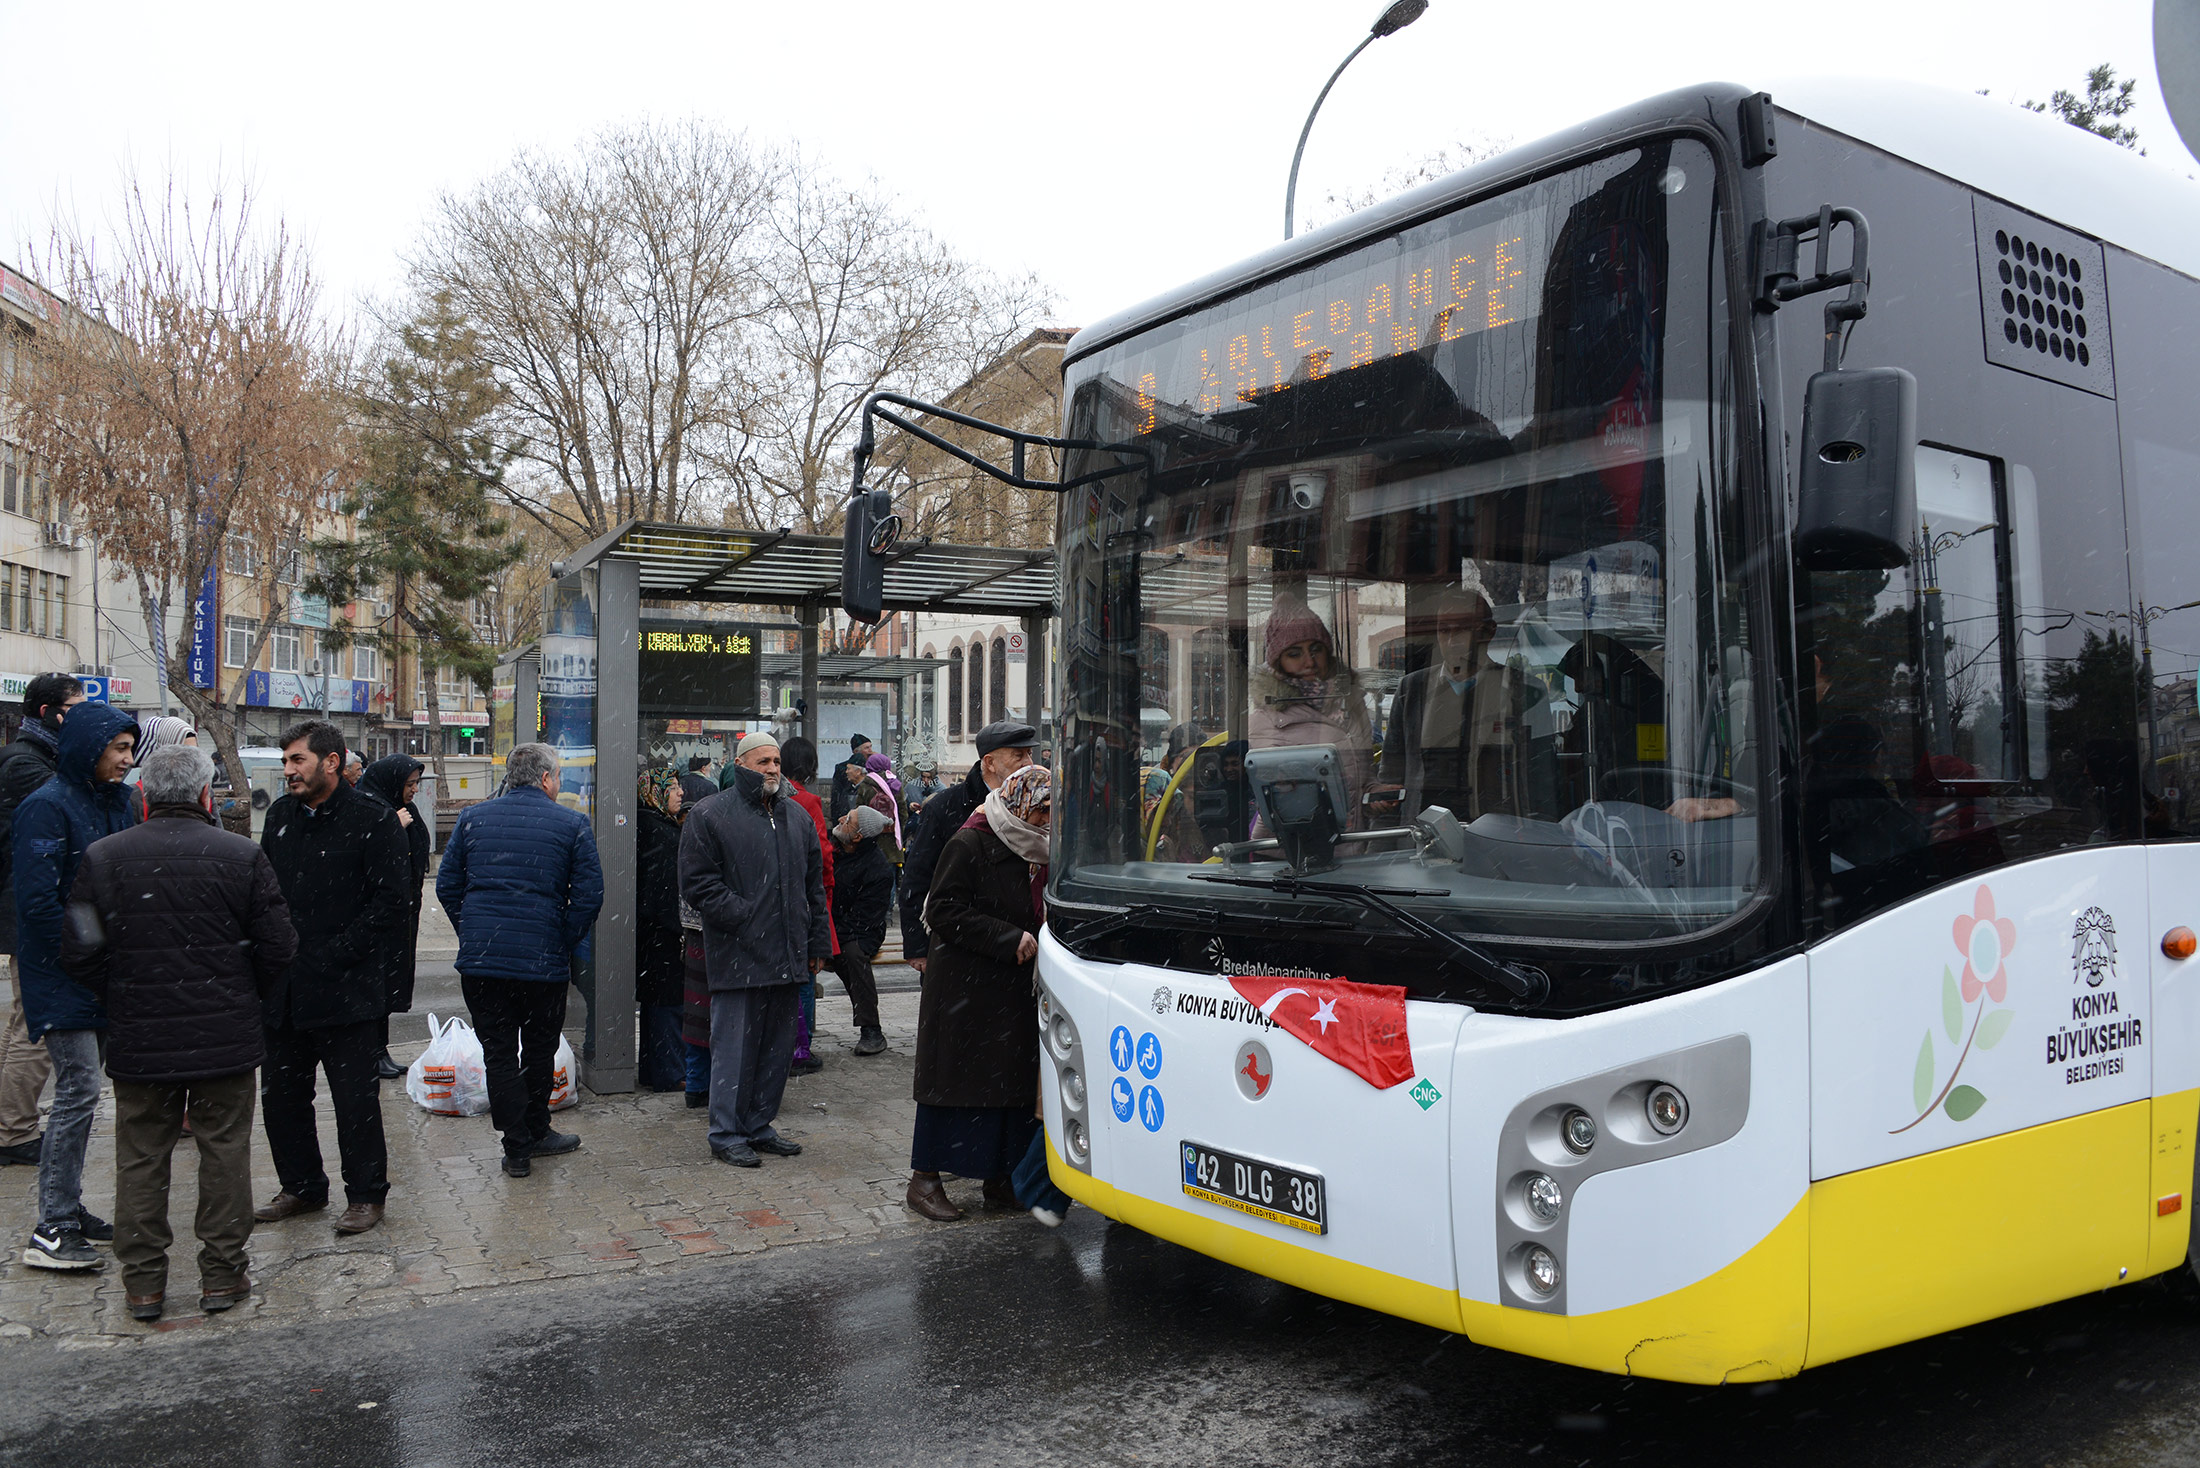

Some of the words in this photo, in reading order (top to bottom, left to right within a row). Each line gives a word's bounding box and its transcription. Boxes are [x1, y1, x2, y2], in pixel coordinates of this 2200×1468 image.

[194, 601, 205, 683] KÜLTÜR
[648, 632, 682, 642] MERAM
[713, 643, 720, 653] H
[726, 644, 751, 654] 33dk
[4, 679, 26, 695] TEXAS
[84, 680, 102, 700] P
[1177, 993, 1217, 1018] KONYA
[2072, 991, 2119, 1020] KONYA
[2046, 1013, 2142, 1064] BÜYÜKŞEHİR
[2066, 1053, 2124, 1085] BELEDİYESİ
[1414, 1087, 1437, 1102] CNG
[1192, 1188, 1210, 1200] KONYA
[1197, 1153, 1220, 1189] 42
[1235, 1162, 1273, 1204] DLG
[1290, 1177, 1317, 1217] 38
